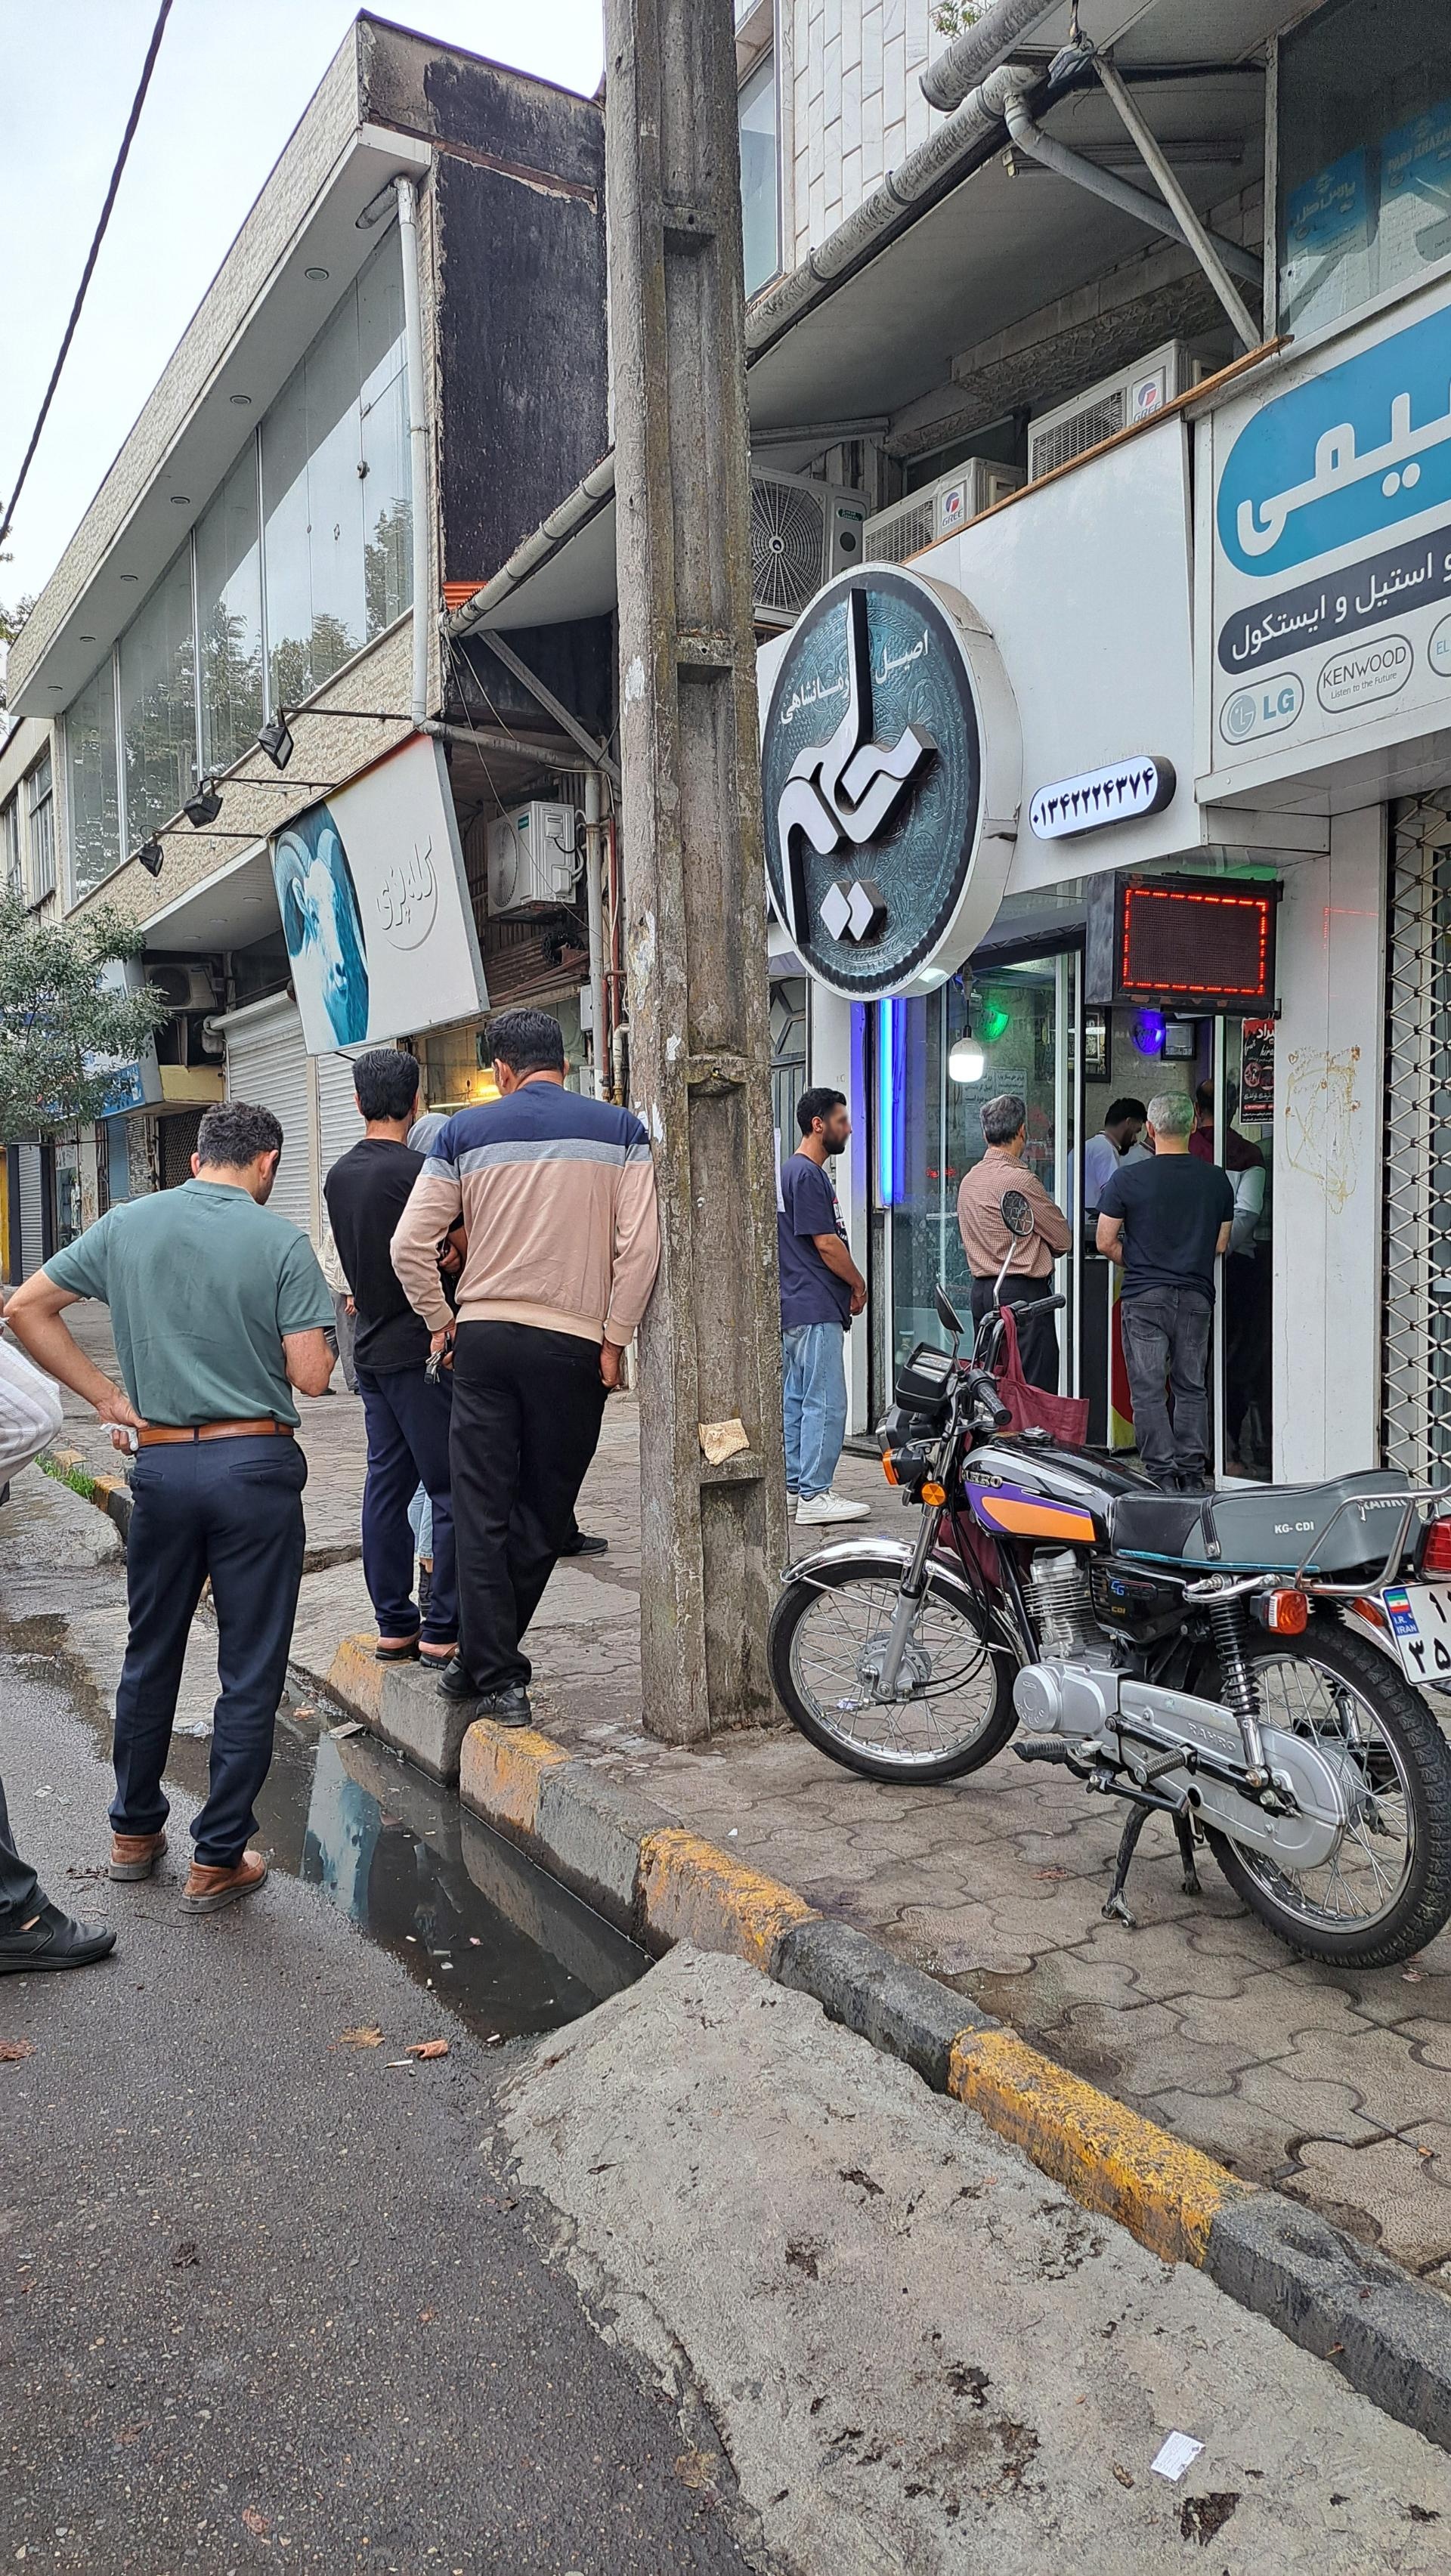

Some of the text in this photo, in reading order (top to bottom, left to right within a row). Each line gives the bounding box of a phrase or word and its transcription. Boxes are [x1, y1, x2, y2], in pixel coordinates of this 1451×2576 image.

[1134, 400, 1161, 423] GREE
[1237, 376, 1451, 556] یمی
[942, 508, 963, 527] GREE
[1355, 552, 1433, 614] استیل
[1335, 595, 1347, 624] و
[1232, 594, 1326, 660] ایستکول
[781, 629, 929, 725] اصیل رمانشاهی
[1323, 646, 1407, 689] KENWOOD
[1330, 673, 1398, 700] Listen to the Future
[1263, 688, 1295, 721] LG
[1032, 766, 1155, 827] ۰۱۳۴۲۲۲۴۳۷۴
[1295, 1521, 1314, 1532] CDI
[1112, 1606, 1126, 1614] CDI
[1396, 1625, 1418, 1634] IRAN
